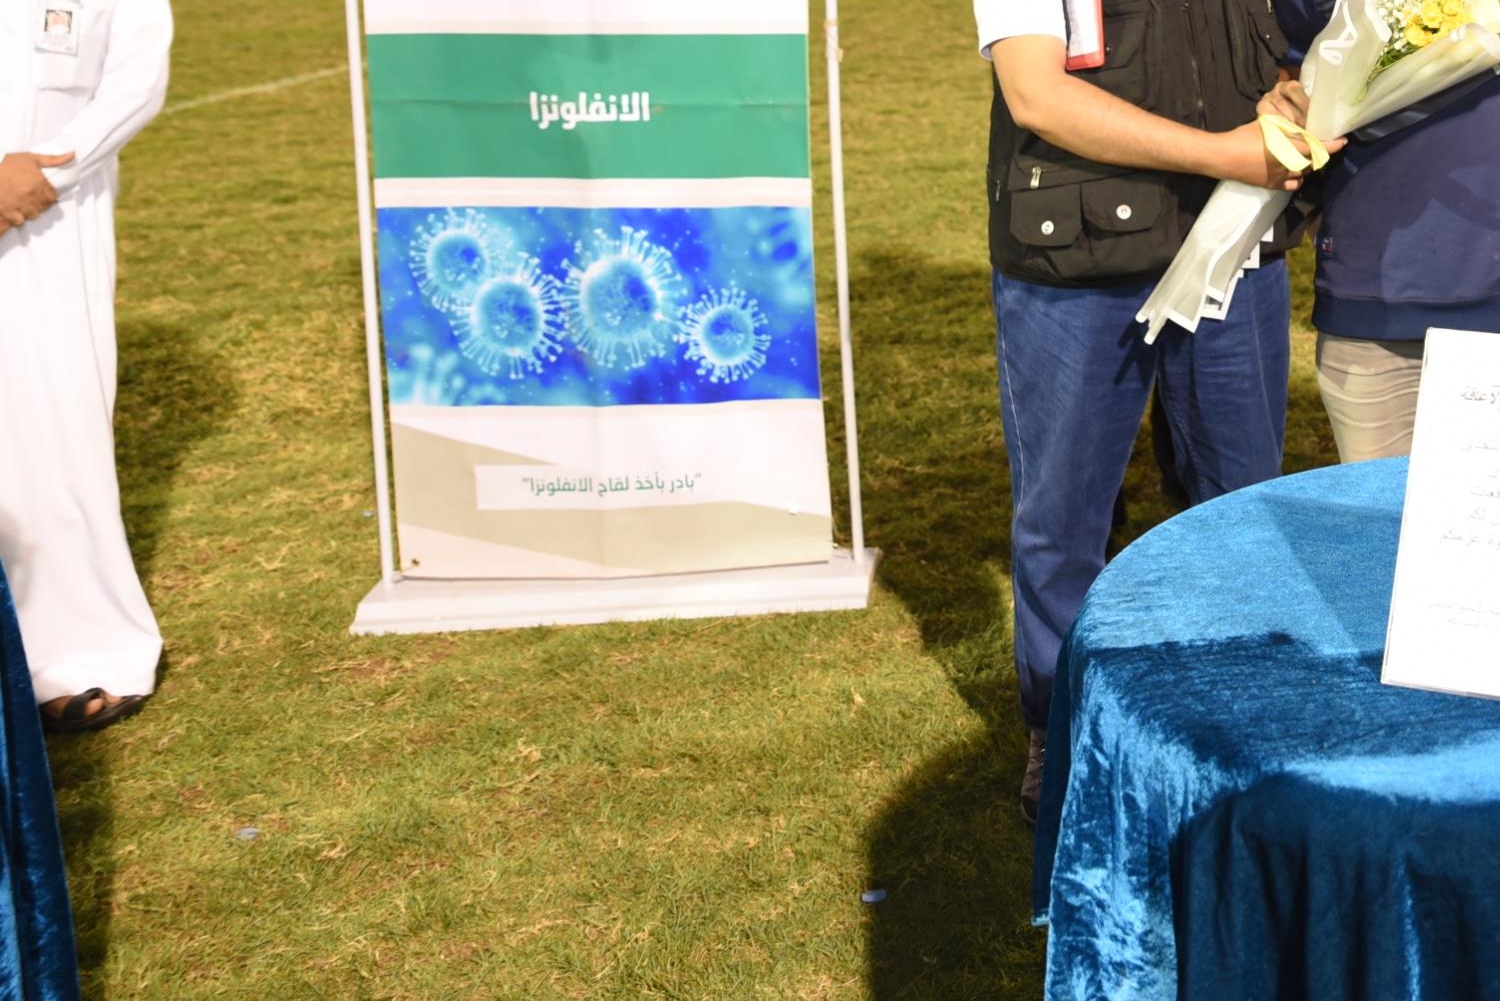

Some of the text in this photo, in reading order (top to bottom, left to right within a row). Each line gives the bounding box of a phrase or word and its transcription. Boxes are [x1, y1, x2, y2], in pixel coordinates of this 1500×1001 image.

[529, 91, 650, 130] الانفلونزا
[597, 475, 630, 498] لقاح
[635, 471, 665, 494] بأخذ
